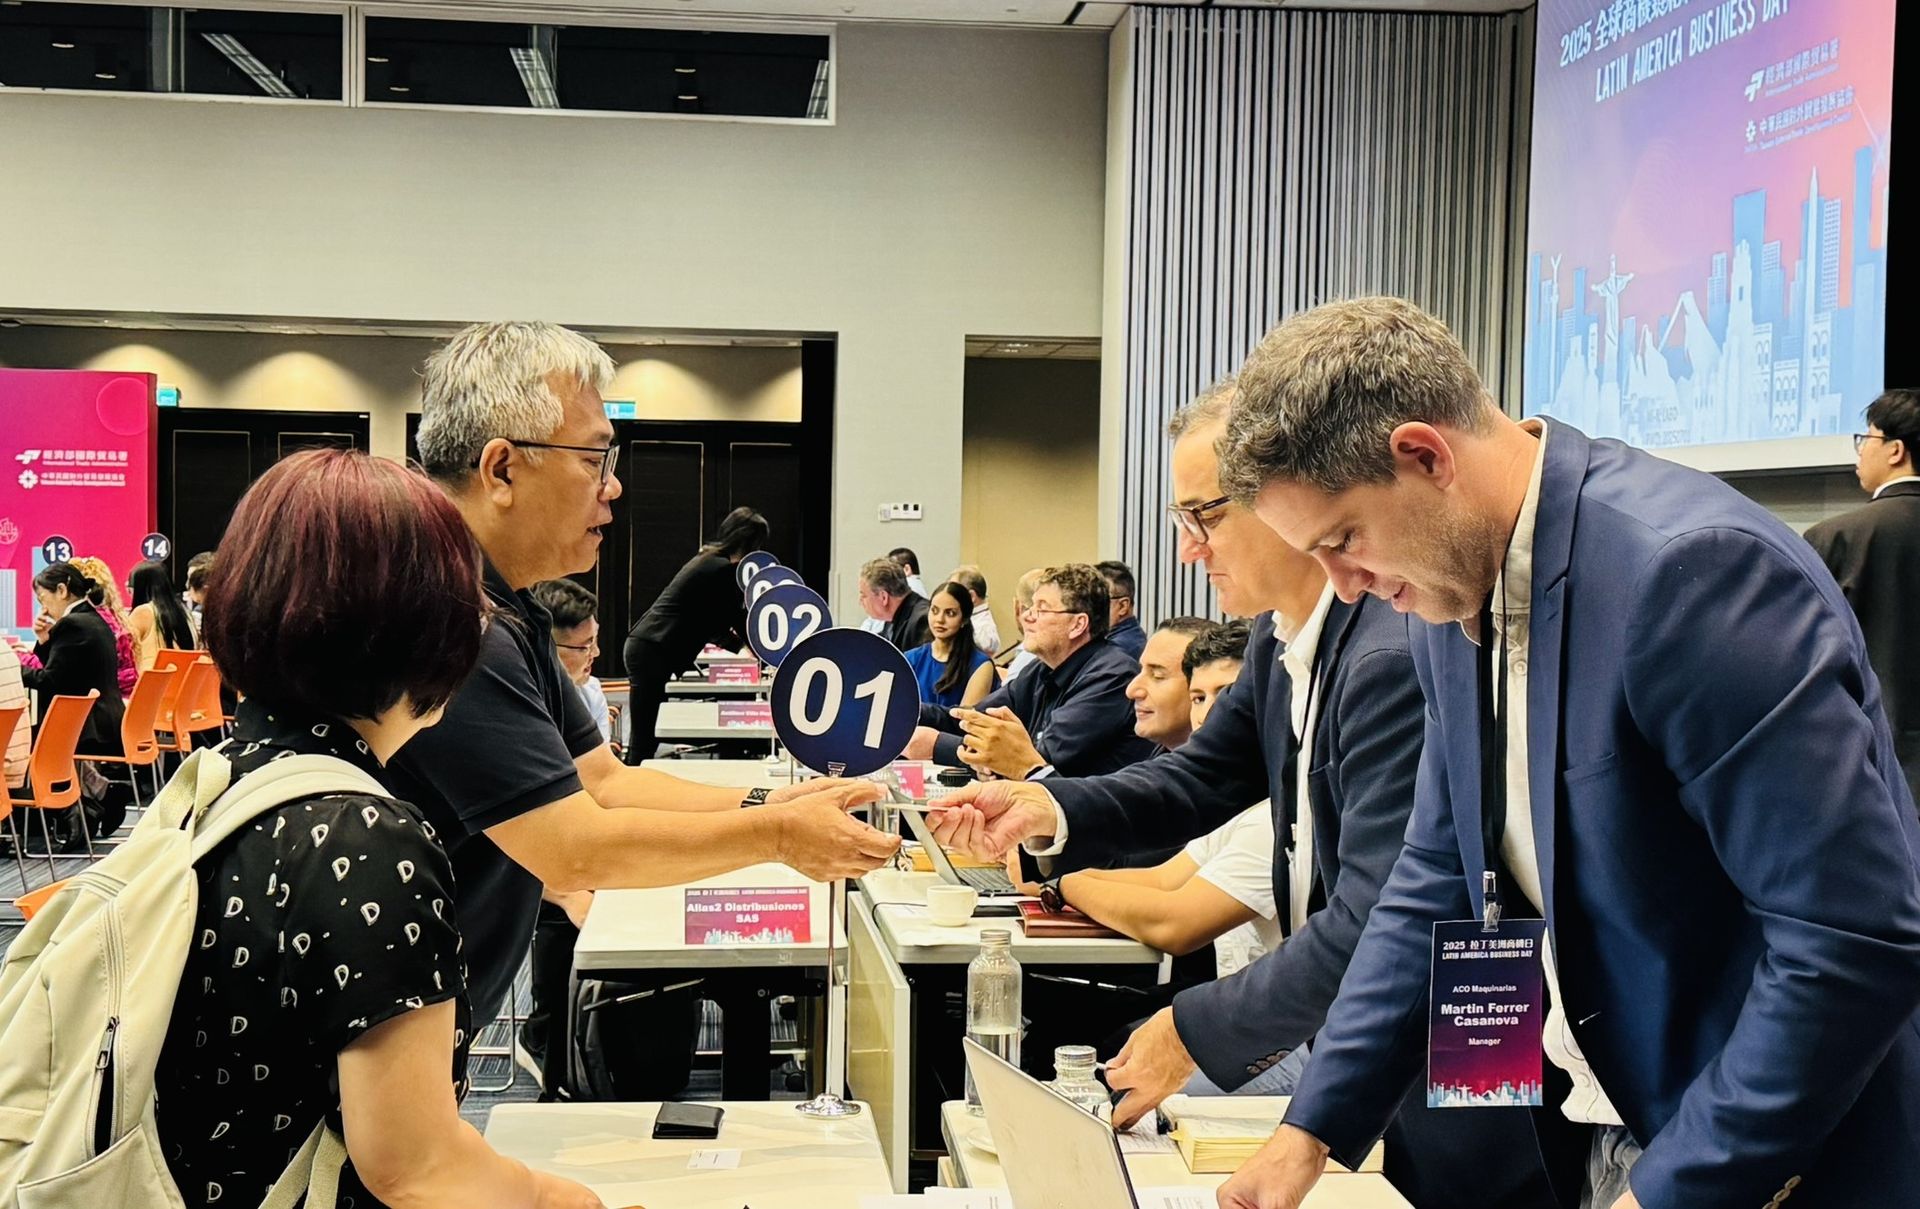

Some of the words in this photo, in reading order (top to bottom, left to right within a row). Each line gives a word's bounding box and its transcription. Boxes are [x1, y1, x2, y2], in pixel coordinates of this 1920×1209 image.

[1560, 19, 1592, 67] 2025
[1595, 53, 1628, 102] LATIN
[1632, 25, 1683, 85] AMERICA
[1689, 0, 1756, 56] BUSINESS
[46, 542, 71, 562] 13
[144, 539, 168, 557] 14
[758, 603, 821, 651] 02
[789, 657, 895, 749] 01
[736, 914, 759, 923] SAS
[1443, 941, 1466, 950] 2025
[1442, 952, 1459, 960] LATIN
[1460, 951, 1488, 959] AMERICA
[1490, 951, 1519, 959] BUSINESS
[1452, 985, 1470, 993] ACO
[1471, 984, 1517, 994] Maquinarias
[1441, 1003, 1484, 1014] Martin
[1488, 1003, 1530, 1013] Ferrer
[1454, 1016, 1519, 1026] Casanova
[1468, 1038, 1501, 1046] Manager
